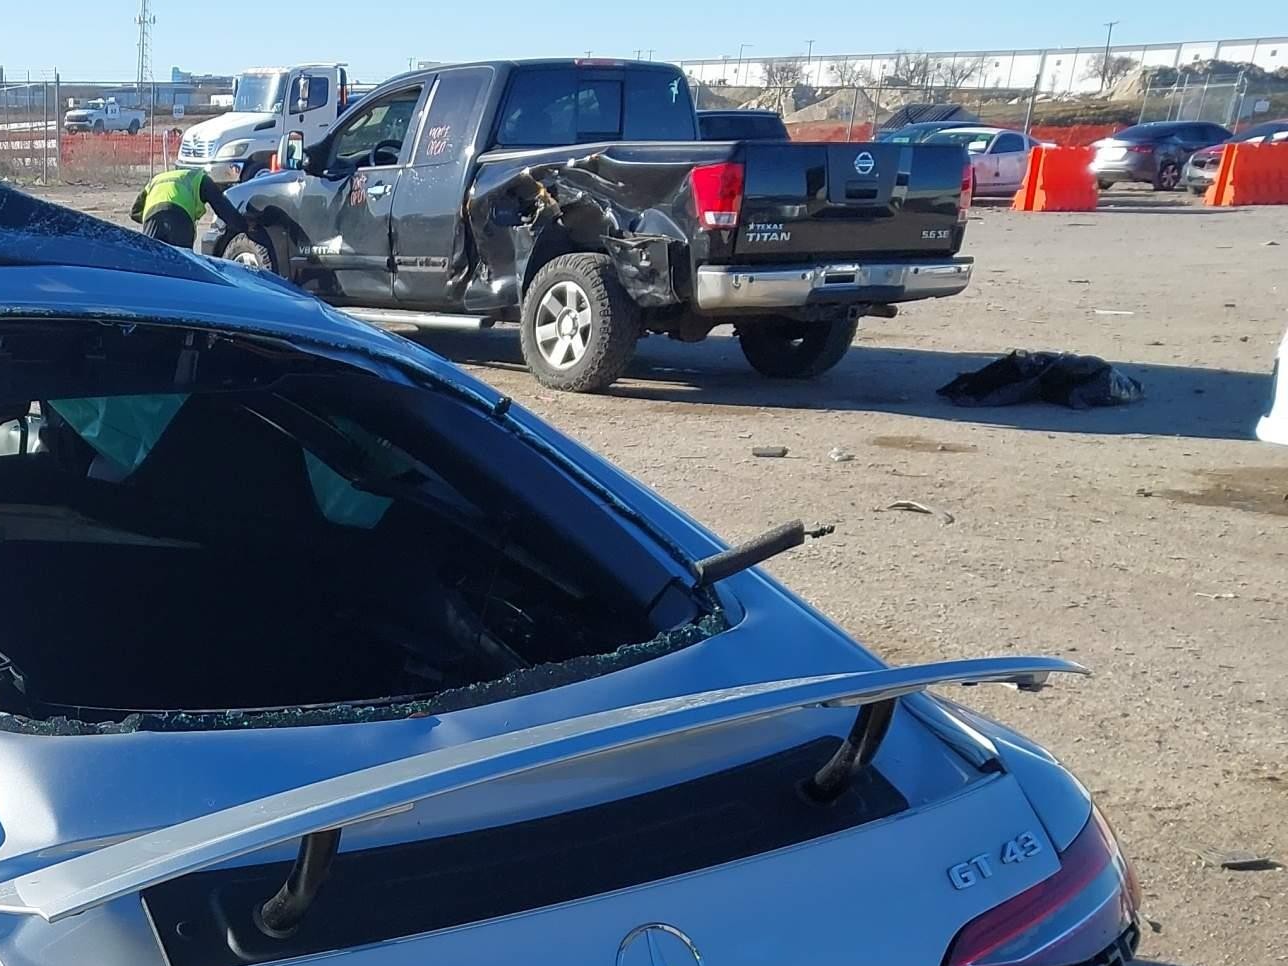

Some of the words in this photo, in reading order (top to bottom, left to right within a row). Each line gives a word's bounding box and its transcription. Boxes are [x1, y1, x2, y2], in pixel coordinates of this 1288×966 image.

[746, 231, 791, 242] TITAN
[298, 245, 310, 254] V8
[311, 245, 340, 254] TITAN
[947, 853, 992, 890] GT
[1000, 831, 1042, 864] 43
